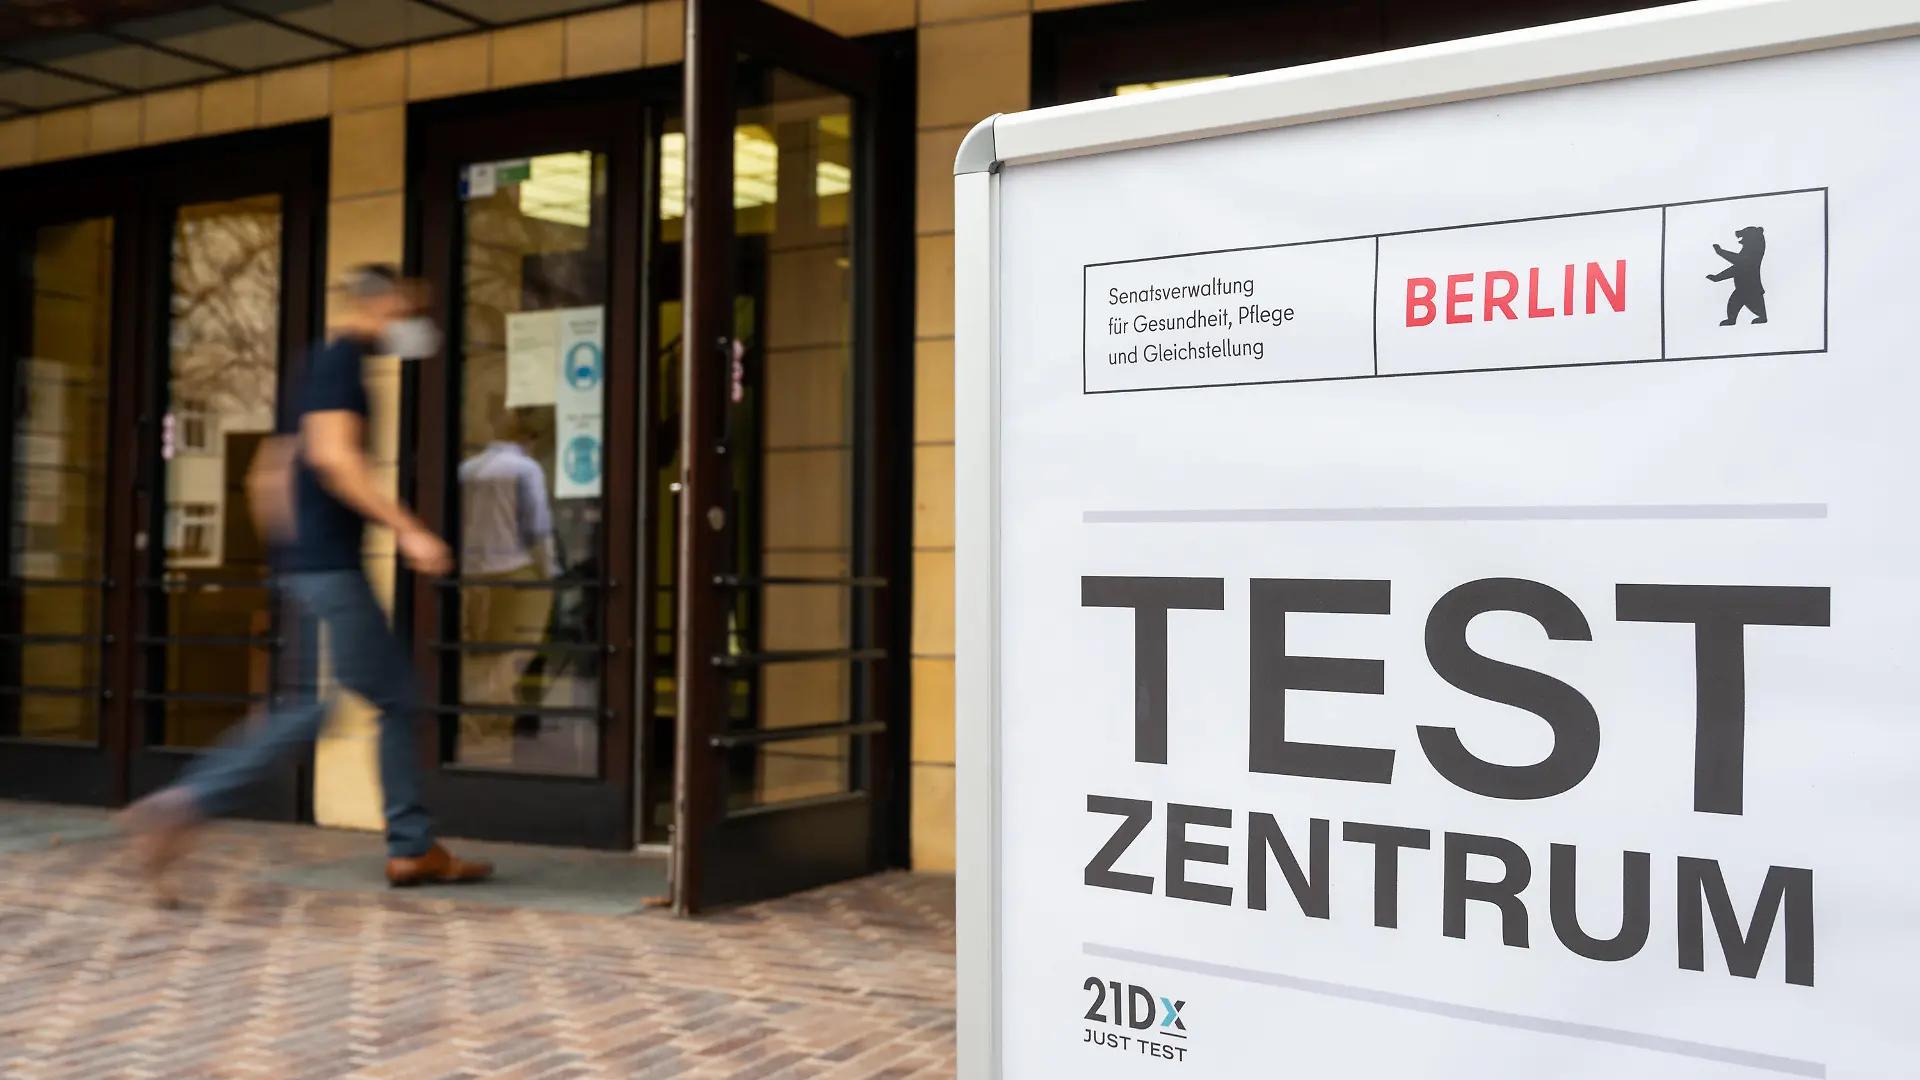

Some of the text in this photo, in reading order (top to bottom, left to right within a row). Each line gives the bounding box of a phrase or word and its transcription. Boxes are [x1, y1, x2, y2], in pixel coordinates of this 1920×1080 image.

[1108, 276, 1255, 306] Senatsverwaltung
[1405, 259, 1627, 328] BERLIN
[1108, 304, 1295, 336] für Gesundheit, Pflege
[1108, 338, 1264, 365] und Gleichstellung
[1081, 576, 1831, 816] TEST
[1084, 794, 1815, 988] ZENTRUM
[1083, 1028, 1188, 1062] JUST TEST
